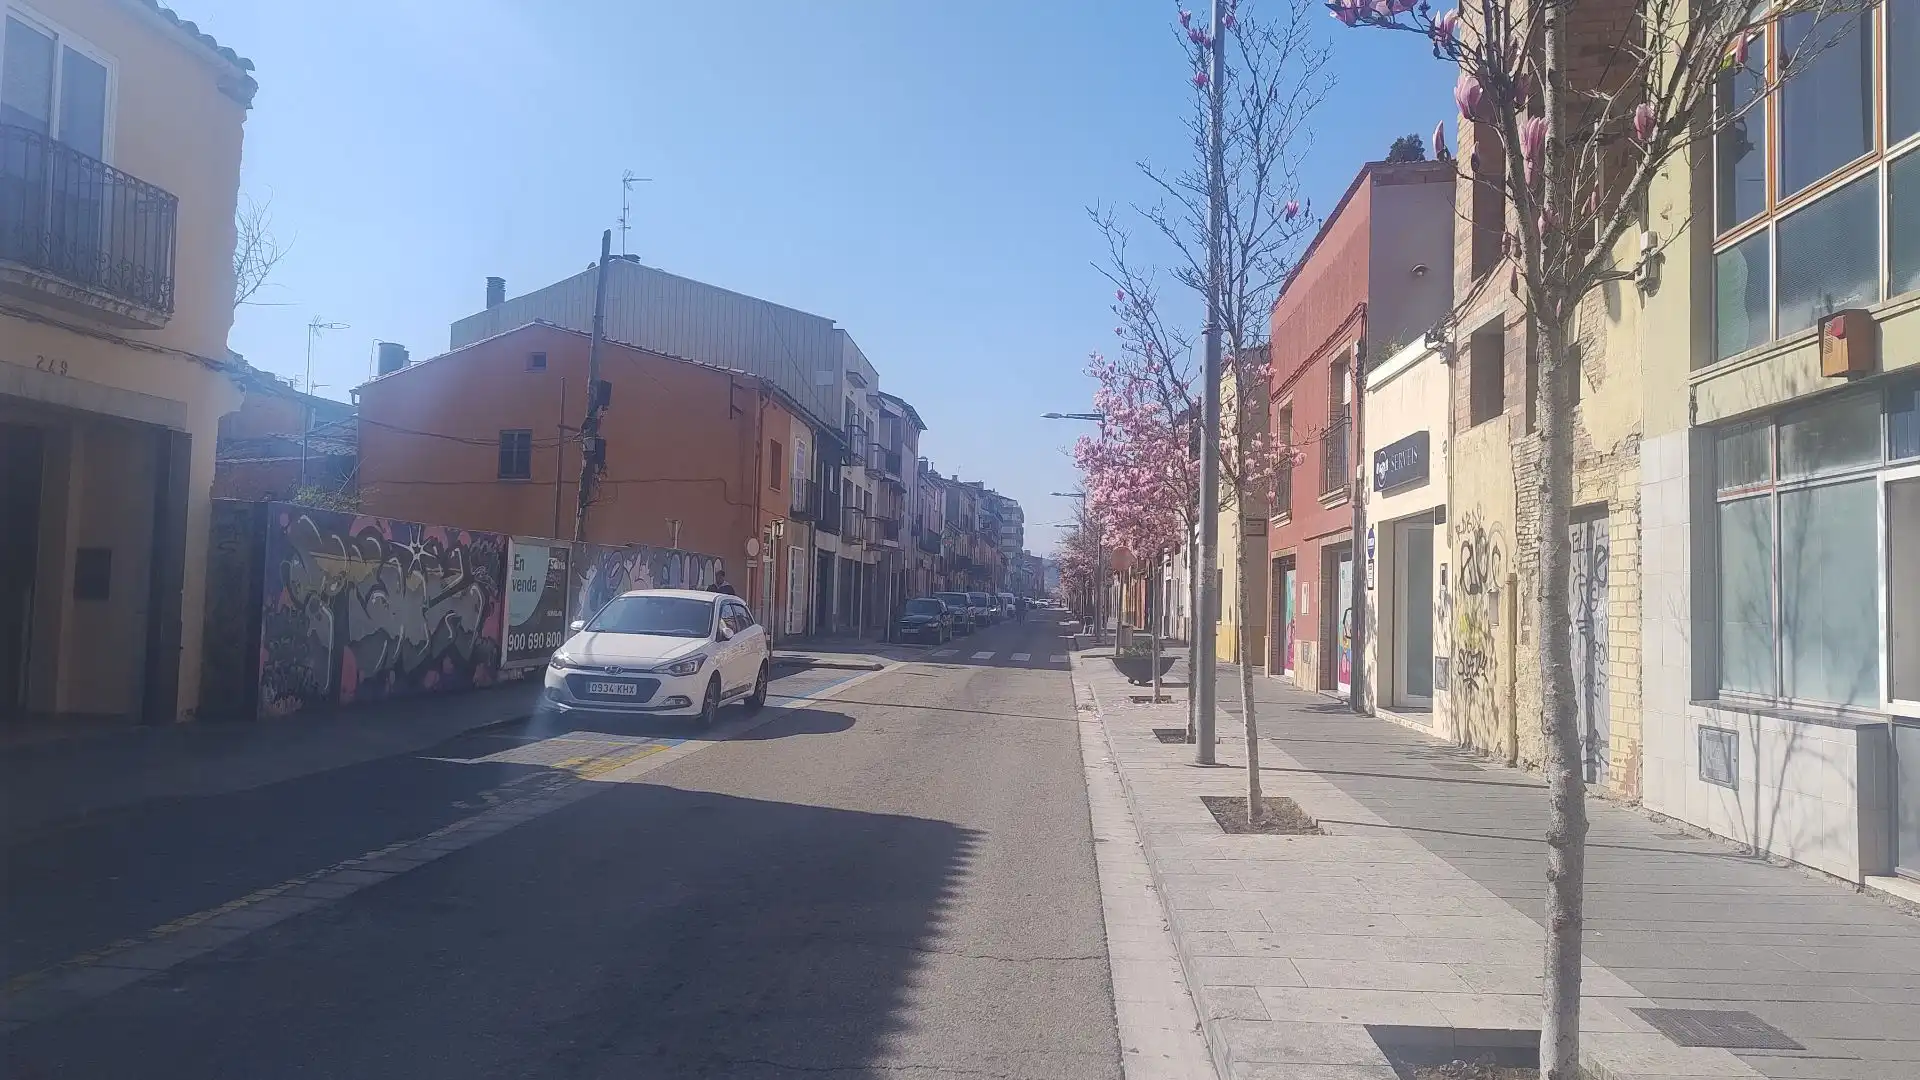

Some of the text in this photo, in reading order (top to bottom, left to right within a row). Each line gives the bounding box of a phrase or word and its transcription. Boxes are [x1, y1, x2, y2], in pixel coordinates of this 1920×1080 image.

[1390, 446, 1418, 472] SERVEIS
[514, 553, 525, 571] En
[512, 575, 537, 593] venda
[508, 631, 562, 651] 900 690 800
[591, 683, 635, 694] 0934 KHX
